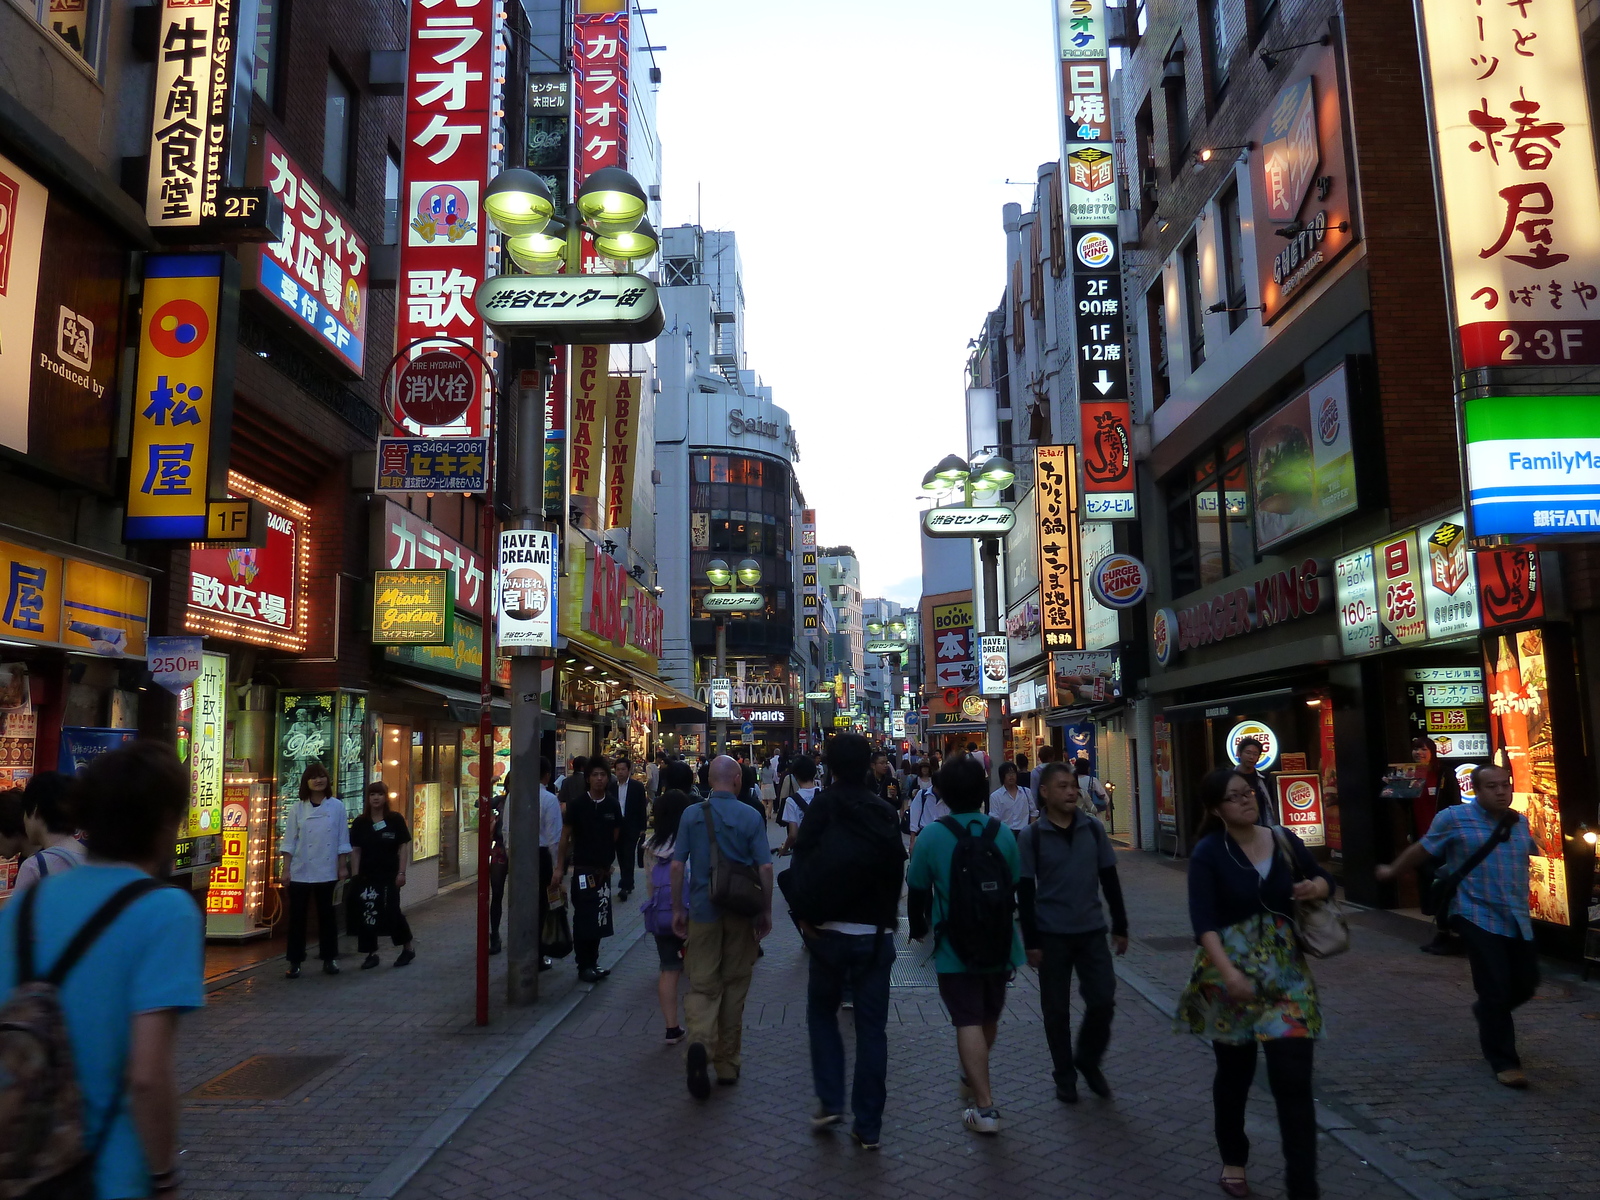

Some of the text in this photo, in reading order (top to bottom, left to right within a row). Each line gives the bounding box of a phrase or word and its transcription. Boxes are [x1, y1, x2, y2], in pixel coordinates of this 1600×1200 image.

[1470, 0, 1498, 81] ーツ
[1063, 49, 1104, 57] ROOM
[413, 0, 484, 165] ラオケ
[531, 83, 567, 92] センター街
[533, 96, 565, 108] 太田ビル
[585, 35, 618, 161] カラオケ
[1069, 65, 1106, 124] 日焼
[155, 17, 207, 220] 牛角食堂
[1077, 124, 1101, 140] 4F
[201, 124, 225, 217] Dining
[1069, 161, 1090, 187] 食
[1091, 161, 1112, 188] 酒
[1265, 150, 1290, 211] 食
[1468, 85, 1569, 269] 椿屋
[225, 197, 259, 217] 2F
[269, 153, 366, 276] カラオケ
[1069, 203, 1117, 215] GHETTO
[1082, 239, 1107, 252] BURGER
[1084, 245, 1108, 259] KING
[1273, 210, 1327, 285] GHETTO
[1087, 279, 1108, 296] 2F
[1470, 280, 1598, 310] つばきや
[486, 287, 648, 310] 渋谷センター街
[1079, 299, 1118, 317] 90席
[280, 273, 352, 349] 受付 2F
[1090, 323, 1111, 341] 1F
[1081, 344, 1121, 362] 12席
[412, 360, 462, 370] FIRE HYDRANT
[41, 353, 106, 399] Produced by
[405, 374, 469, 404] 消火栓
[728, 409, 780, 440] Saint
[140, 375, 204, 497] 松屋
[421, 442, 482, 453] 3464-2061
[382, 443, 410, 476] 質
[410, 453, 483, 477] セキネ
[380, 477, 403, 488] 買取
[1039, 461, 1066, 536] ちりとり鍋
[1087, 499, 1133, 513] センタービル
[217, 511, 246, 532] 1F
[930, 514, 1011, 526] 渋谷センター街
[502, 534, 550, 550] HAVE A
[390, 516, 484, 607] カラオケ
[502, 550, 550, 564] DREAM!
[1338, 552, 1372, 577] カラオケ
[1102, 565, 1139, 583] BURGER
[1104, 573, 1141, 595] KING
[1347, 571, 1366, 587] BOX
[1383, 539, 1417, 623] 日焼
[3, 561, 46, 633] 屋
[191, 571, 287, 625] 歌広場
[377, 588, 431, 607] Miami
[503, 589, 546, 611] 宮崎
[1177, 586, 1251, 652] BURGER
[1255, 558, 1320, 628] KING
[936, 612, 969, 628] BOOK
[1434, 600, 1473, 625] GHETTO
[383, 630, 435, 638] マイアミガーデン
[1384, 634, 1393, 645] 4F
[937, 631, 965, 660] 本
[152, 656, 199, 673] 250円
[985, 665, 1006, 677] 大分
[1427, 685, 1468, 696] カラオケ
[1490, 682, 1541, 717] 赤ちり亭
[730, 710, 785, 722] onald's
[1291, 787, 1309, 796] BURGER
[1292, 792, 1311, 803] KING
[1289, 812, 1317, 822] 102席
